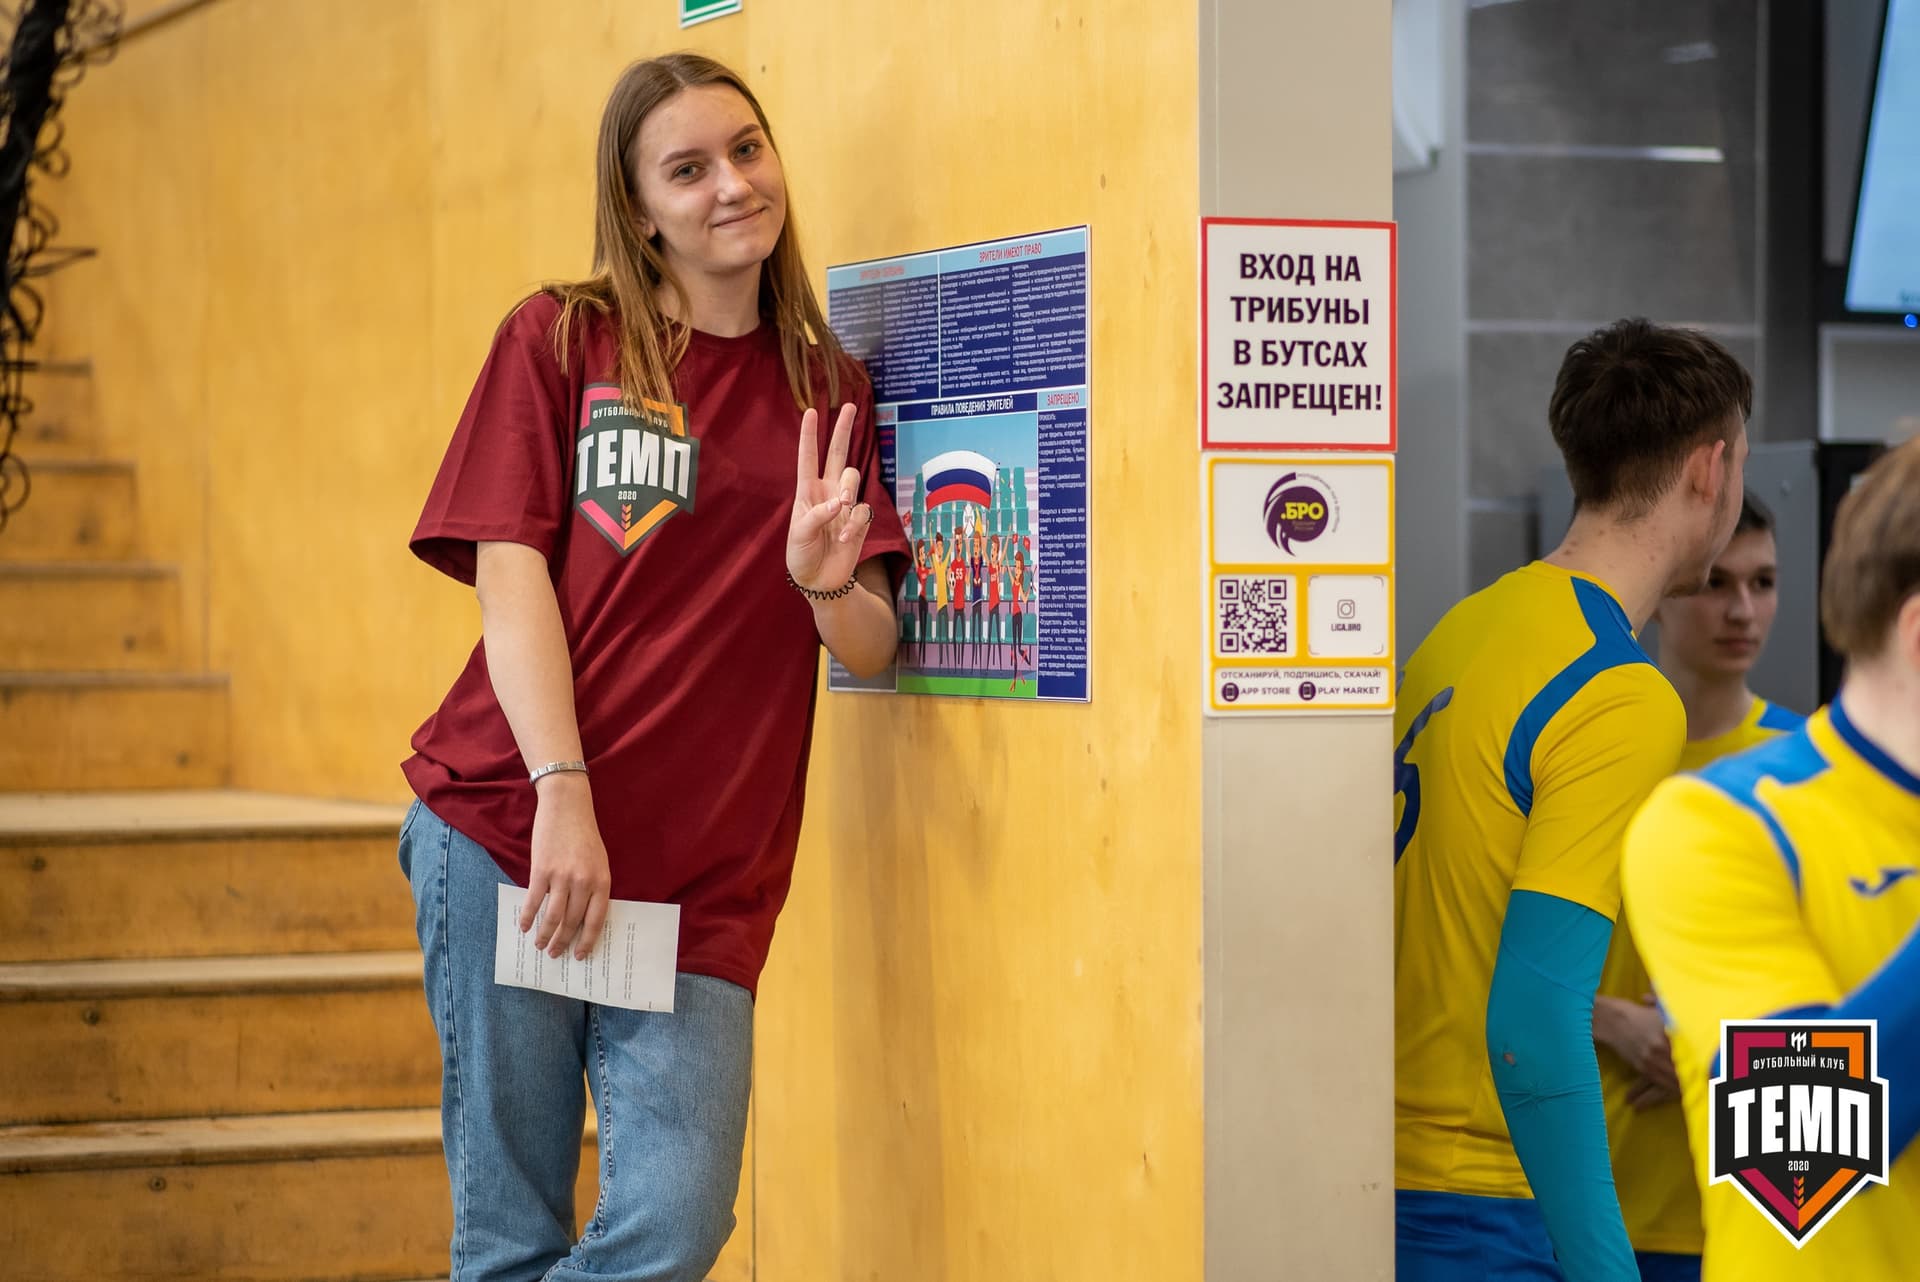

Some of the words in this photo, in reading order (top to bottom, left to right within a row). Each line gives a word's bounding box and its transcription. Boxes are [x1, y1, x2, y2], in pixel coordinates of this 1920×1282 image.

[979, 250, 1003, 263] ЗРИТЕЛИ
[1004, 246, 1023, 259] ИМЕЮТ
[1024, 242, 1042, 255] ПРАВО
[1240, 253, 1316, 286] ВХОД
[1325, 255, 1361, 282] НА
[1230, 296, 1369, 325] ТРИБУНЫ
[1233, 340, 1252, 366] В
[1261, 340, 1368, 368] БУТСАХ
[931, 403, 955, 416] ПРАВИЛА
[955, 400, 986, 416] ПОВЕДЕНИЯ
[986, 396, 1014, 412] ЗРИТЕЛЕЙ
[1047, 391, 1079, 407] ЗАПРЕЩЕНО
[1217, 382, 1382, 416] ЗАПРЕЩЕН!
[577, 429, 691, 500] ТЕМП
[618, 490, 637, 501] 2020
[1221, 671, 1282, 679] ОТСКАНИРУЙ,
[1284, 671, 1342, 679] ПОДПИШИСЬ,
[1344, 670, 1381, 678] СКАЧАЙ!
[1240, 687, 1258, 695] APP
[1261, 687, 1291, 695] STORE
[1318, 687, 1340, 695] PLAY
[1343, 686, 1380, 694] MARKET
